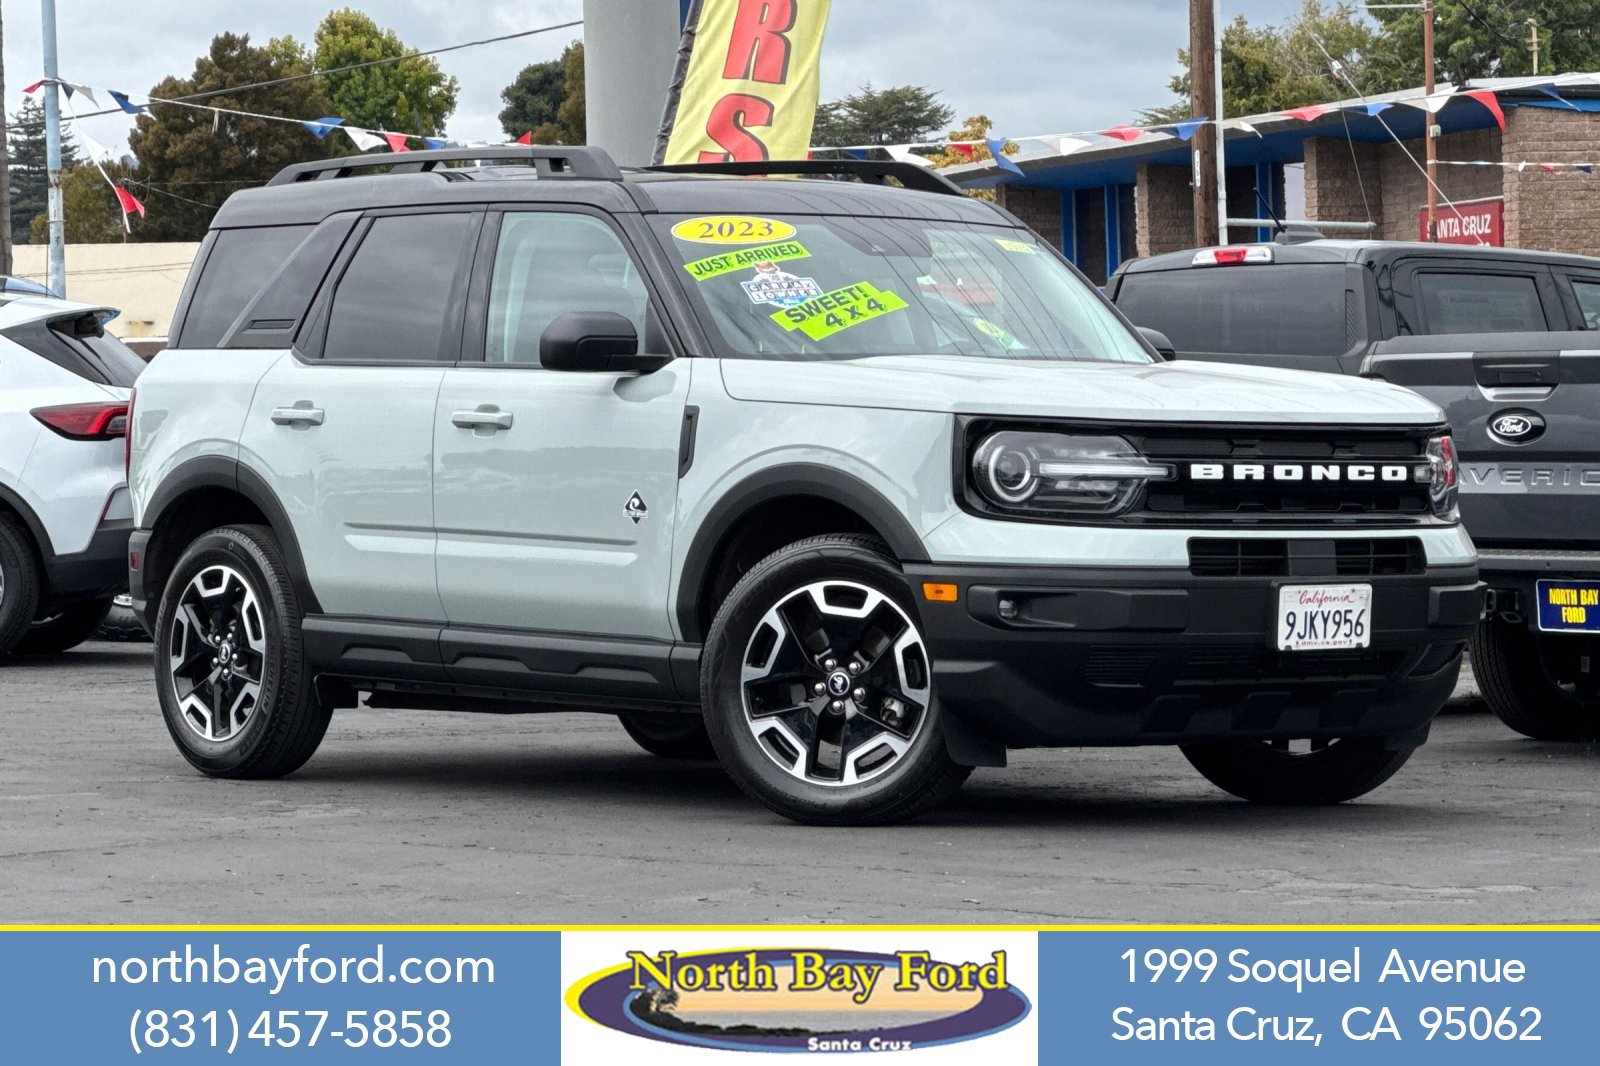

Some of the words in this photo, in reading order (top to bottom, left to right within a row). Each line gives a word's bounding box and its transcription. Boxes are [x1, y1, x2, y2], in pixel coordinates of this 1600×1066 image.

[698, 221, 774, 239] 2023
[1462, 214, 1492, 236] CRUZ
[693, 256, 732, 277] JUST
[735, 243, 804, 266] ARRIVED
[784, 285, 870, 325] SWEET!
[1499, 418, 1524, 433] Ford
[1190, 463, 1408, 481] BRONCO
[1299, 589, 1356, 608] California
[1548, 588, 1578, 605] NORTH
[1580, 588, 1599, 606] BAY
[1284, 608, 1366, 640] 9JKY956
[1561, 606, 1587, 624] FORD
